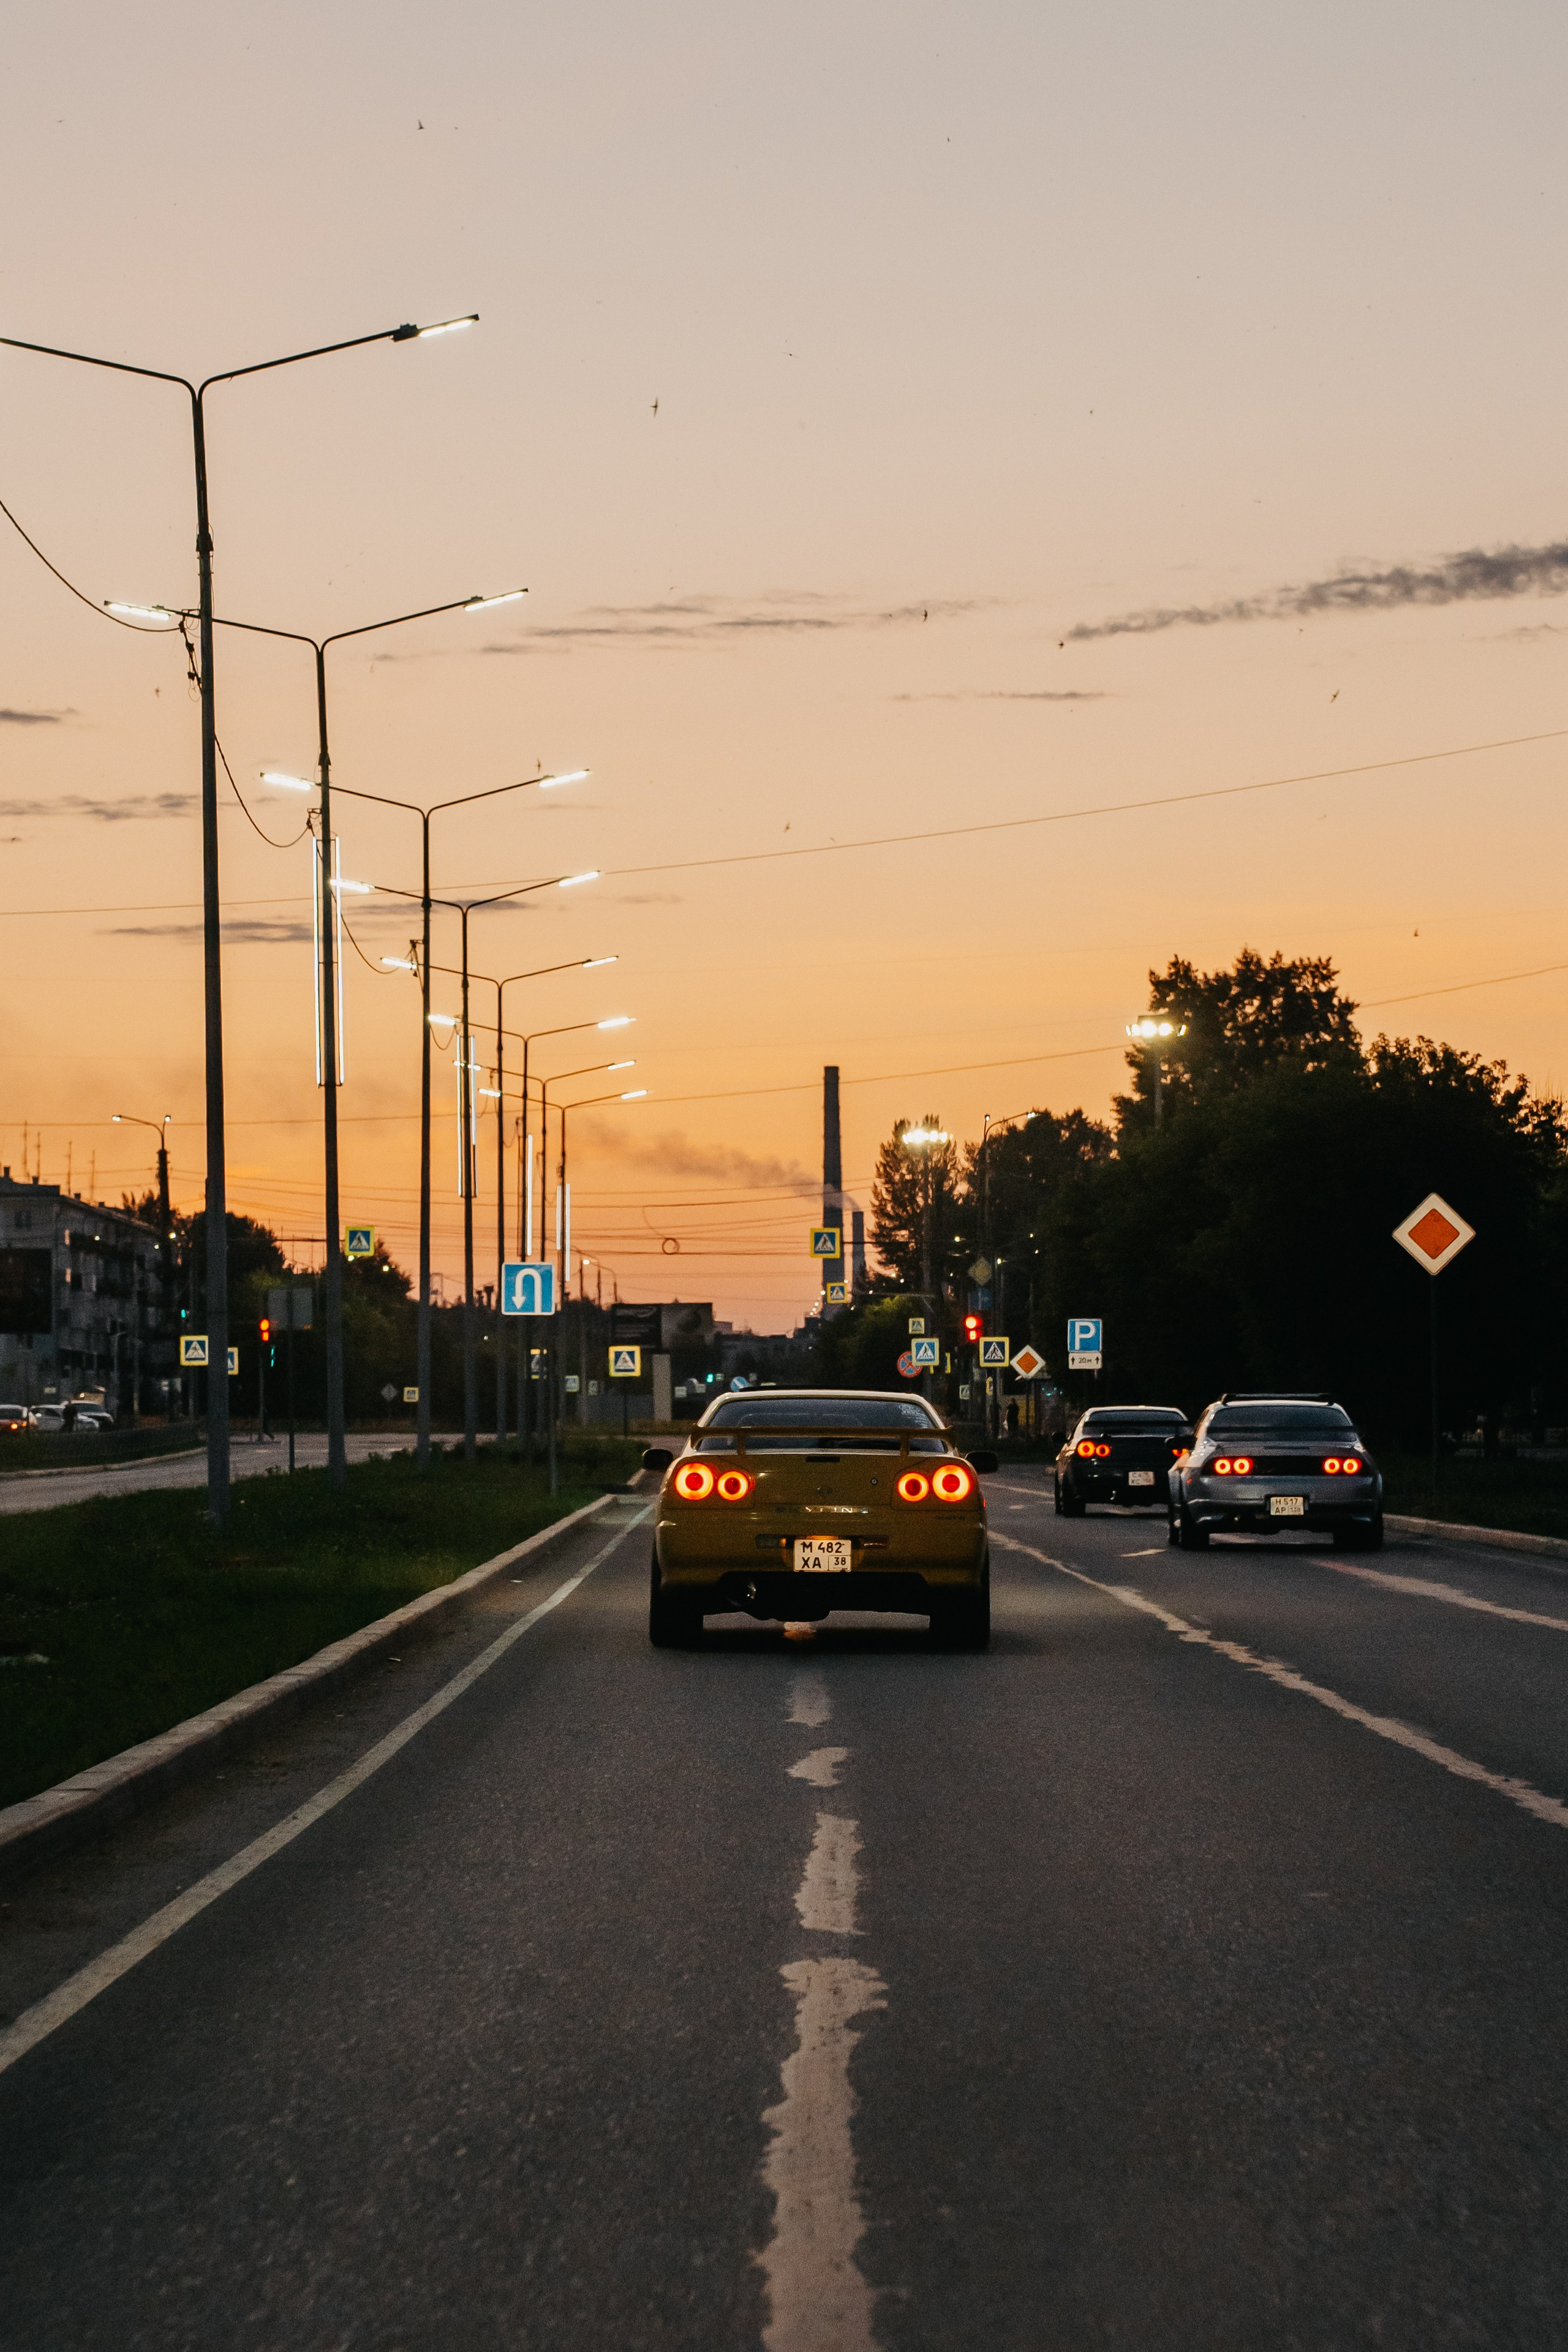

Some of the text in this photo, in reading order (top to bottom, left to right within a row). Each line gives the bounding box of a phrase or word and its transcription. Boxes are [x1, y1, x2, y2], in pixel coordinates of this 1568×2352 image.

[1075, 1321, 1095, 1351] P
[801, 1541, 842, 1553] М 482
[801, 1557, 846, 1569] ХА 38
